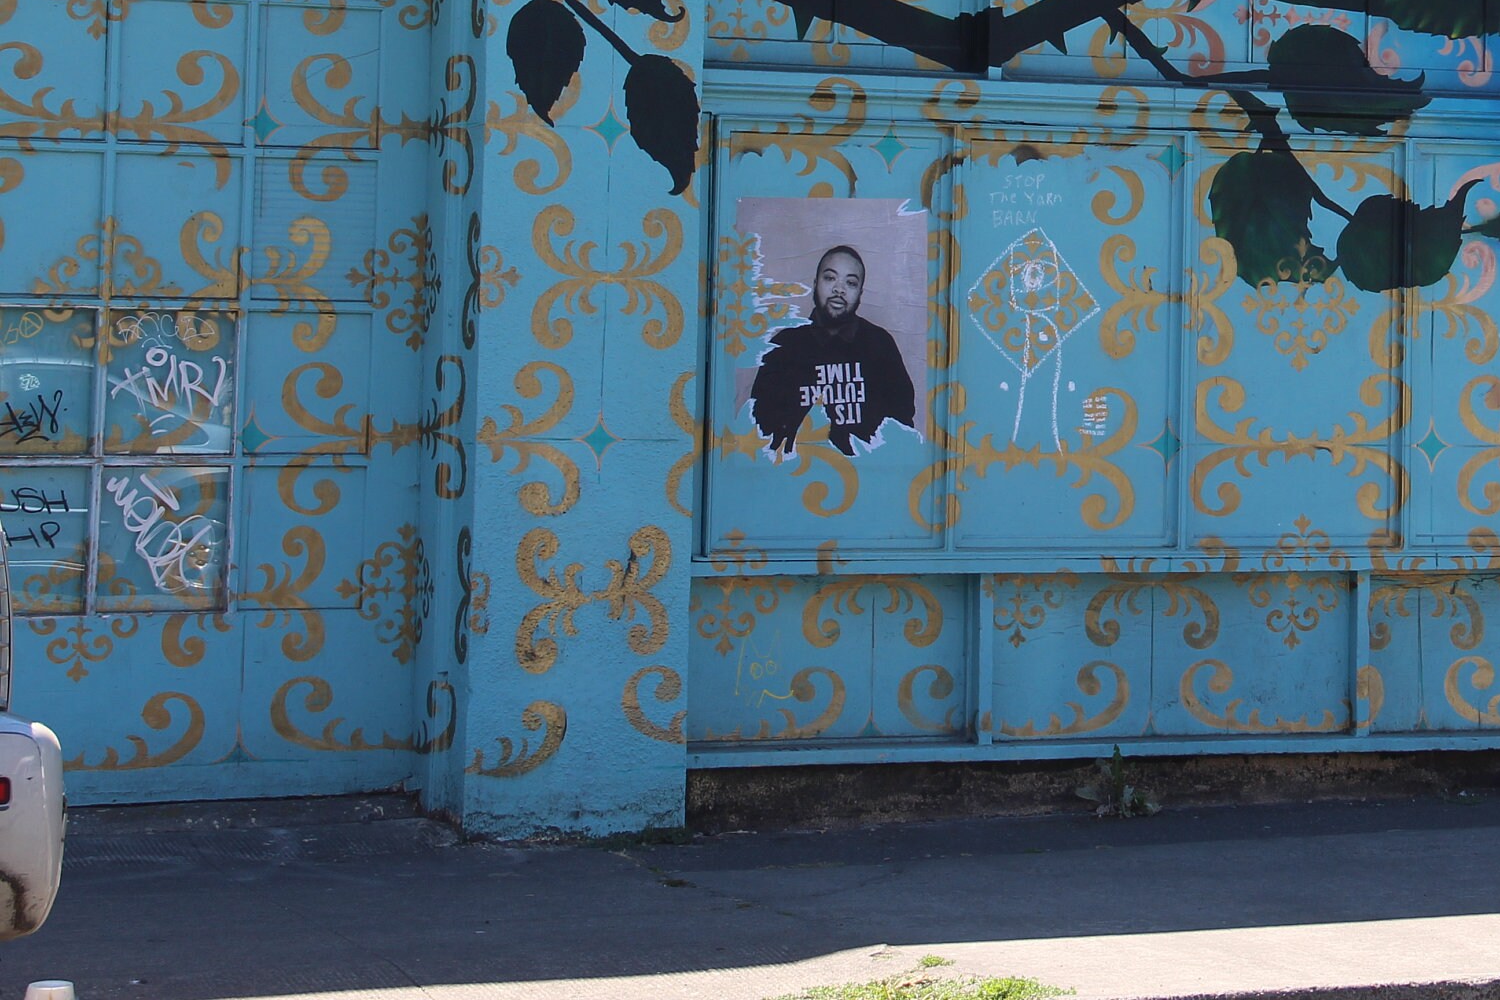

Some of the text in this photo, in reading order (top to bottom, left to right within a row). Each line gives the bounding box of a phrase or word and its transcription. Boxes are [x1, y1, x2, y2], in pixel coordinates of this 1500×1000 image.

[1003, 173, 1046, 190] STOP
[992, 209, 1039, 228] BARN
[814, 362, 865, 385] TIME
[799, 382, 866, 407] FUTURE
[834, 402, 862, 426] ITS
